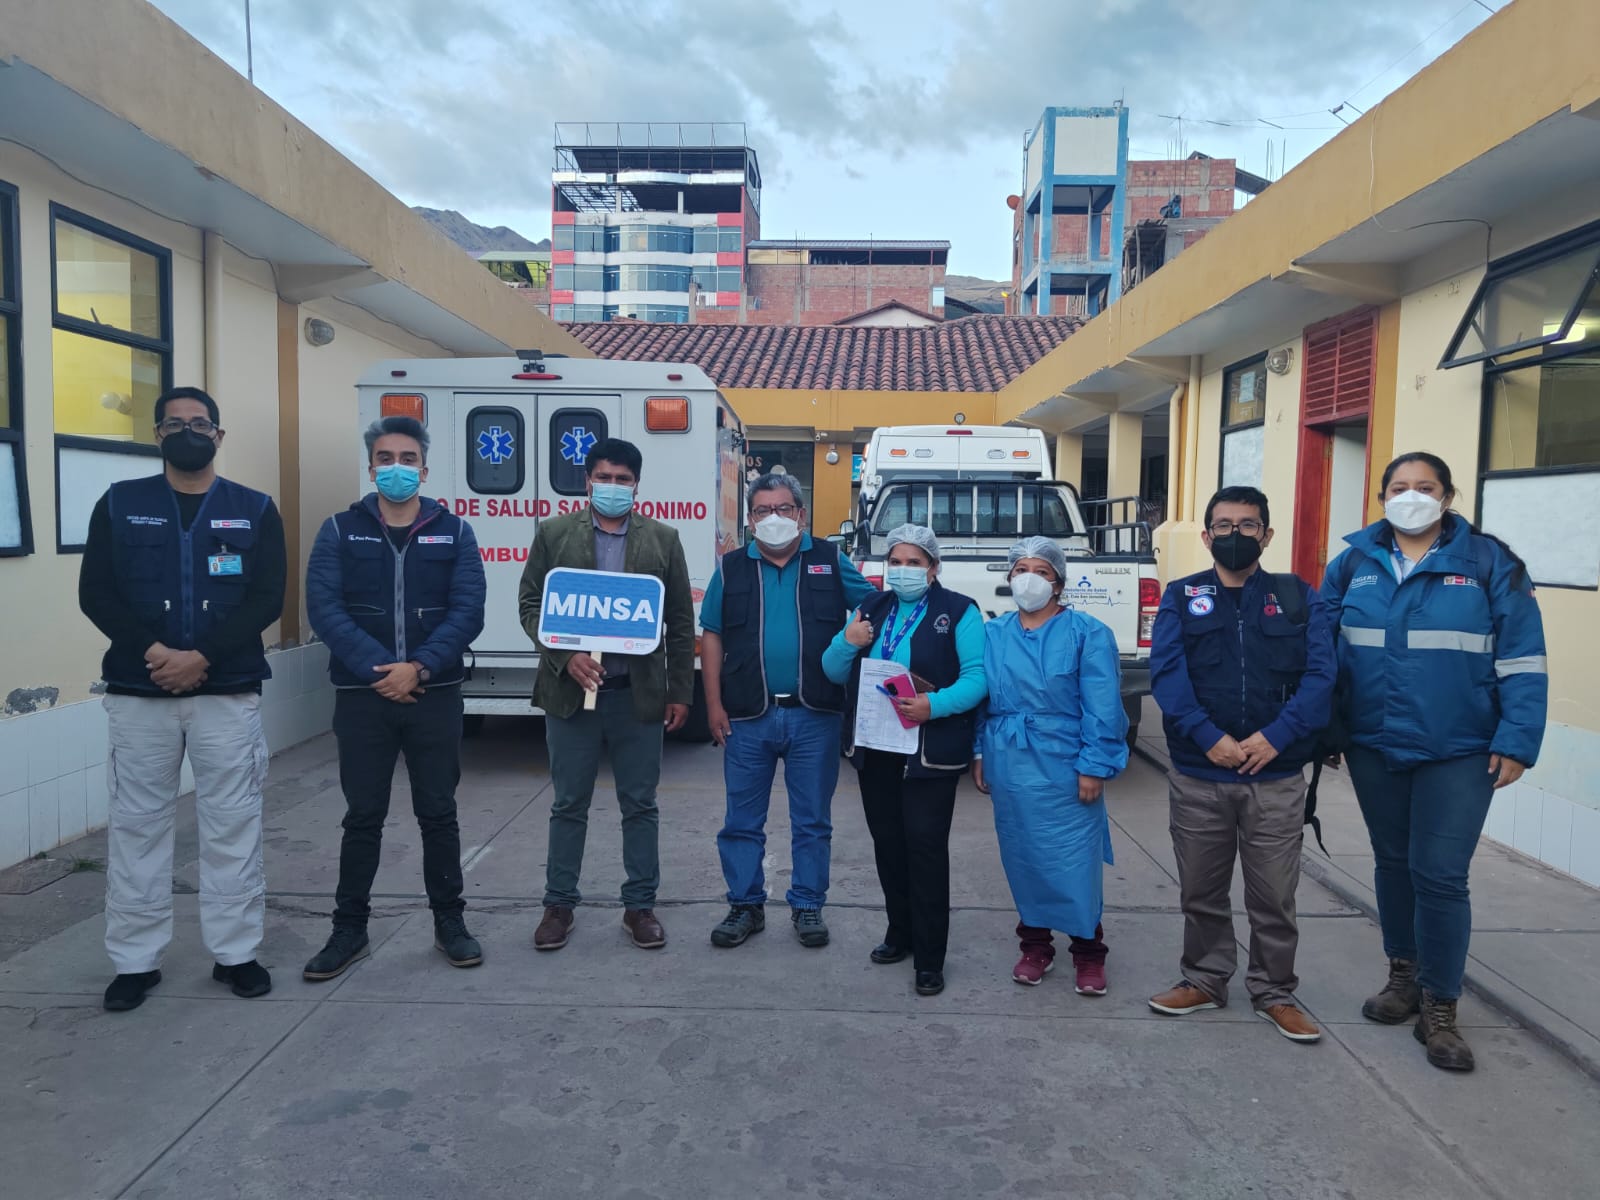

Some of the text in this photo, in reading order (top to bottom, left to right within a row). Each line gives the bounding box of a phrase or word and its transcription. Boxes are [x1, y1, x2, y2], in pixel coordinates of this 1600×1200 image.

[455, 498, 480, 517] DE
[486, 499, 551, 517] SALUD
[546, 591, 656, 623] MINSA
